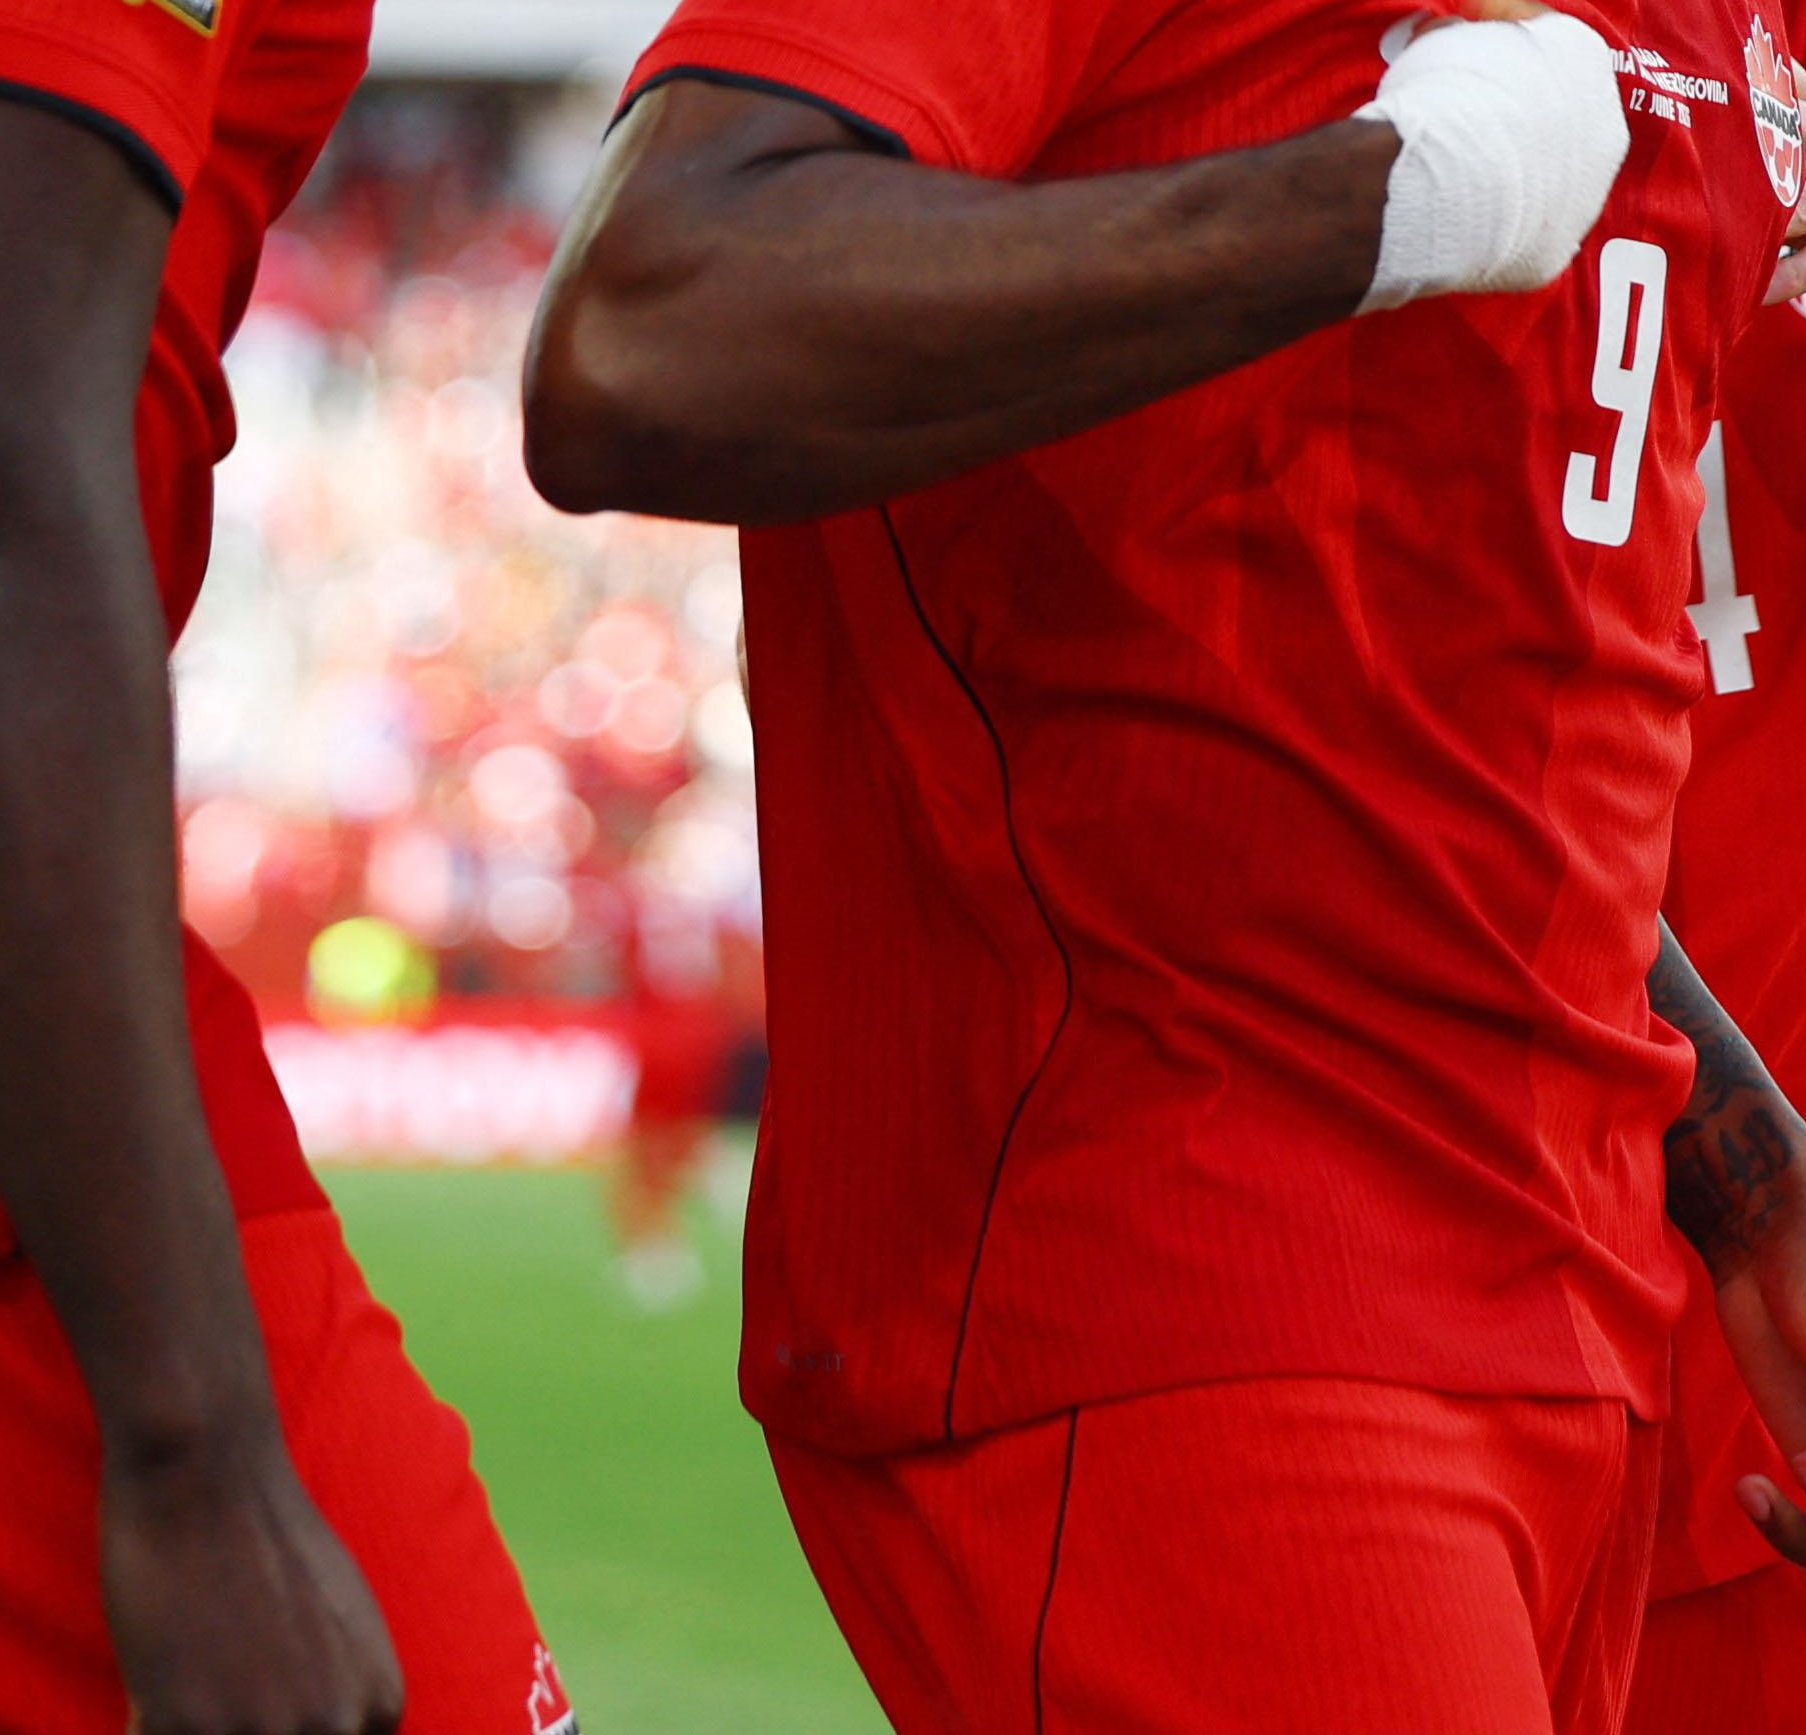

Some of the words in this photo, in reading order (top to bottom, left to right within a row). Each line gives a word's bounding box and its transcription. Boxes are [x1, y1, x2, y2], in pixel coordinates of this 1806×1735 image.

[1629, 87, 1647, 112] 12
[1648, 92, 1676, 122] JUNE
[1752, 90, 1800, 140] CANADA
[1561, 237, 1667, 547] 9
